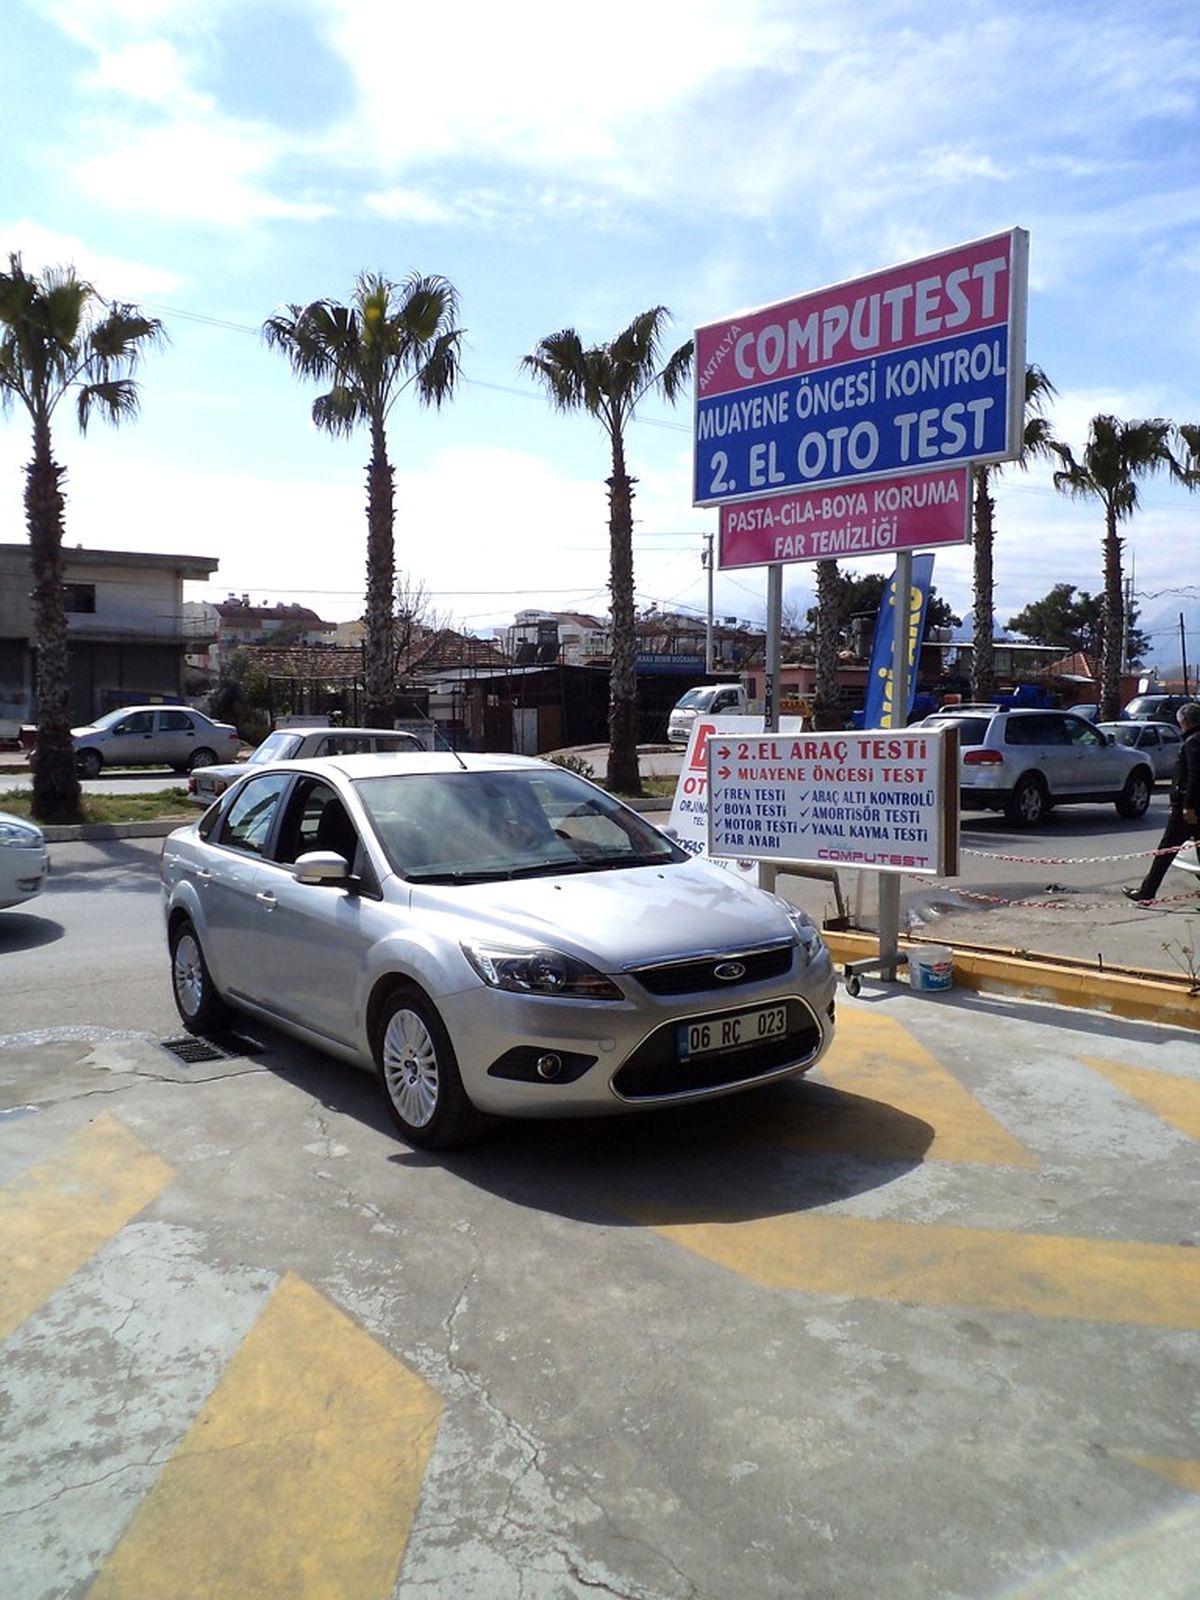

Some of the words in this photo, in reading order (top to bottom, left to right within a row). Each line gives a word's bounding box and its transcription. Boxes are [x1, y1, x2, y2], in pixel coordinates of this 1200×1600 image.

[699, 324, 741, 390] ANTALYA
[734, 256, 1007, 380] COMPUTEST
[697, 391, 789, 441] MUAYENE
[796, 360, 876, 419] ÖNCESİ
[885, 340, 1006, 400] KONTROL
[710, 450, 736, 494] 2.
[749, 441, 785, 487] EL
[797, 421, 879, 478] OTO
[894, 397, 994, 462] TEST
[873, 479, 959, 511] KORUMA
[774, 533, 805, 559] FAR
[811, 516, 897, 553] TEMİZLİĞİ
[738, 743, 782, 760] 2.EL
[790, 741, 848, 764] ARAÇ
[738, 767, 805, 781] MUAYENE
[882, 768, 927, 783] TEST
[724, 788, 751, 800] FREN
[812, 790, 839, 806] ARAÇ
[843, 791, 866, 804] ALTI
[869, 790, 935, 807] KONTROLÜ
[724, 803, 751, 815] BOYA
[724, 818, 762, 832] MOTOR
[812, 823, 846, 837] YANAL
[849, 825, 889, 840] KAYMA
[725, 832, 744, 845] FAR
[748, 835, 780, 848] AYARI
[818, 849, 929, 867] COMPUTEST
[690, 1026, 710, 1050] 06
[758, 1009, 784, 1036] 023
